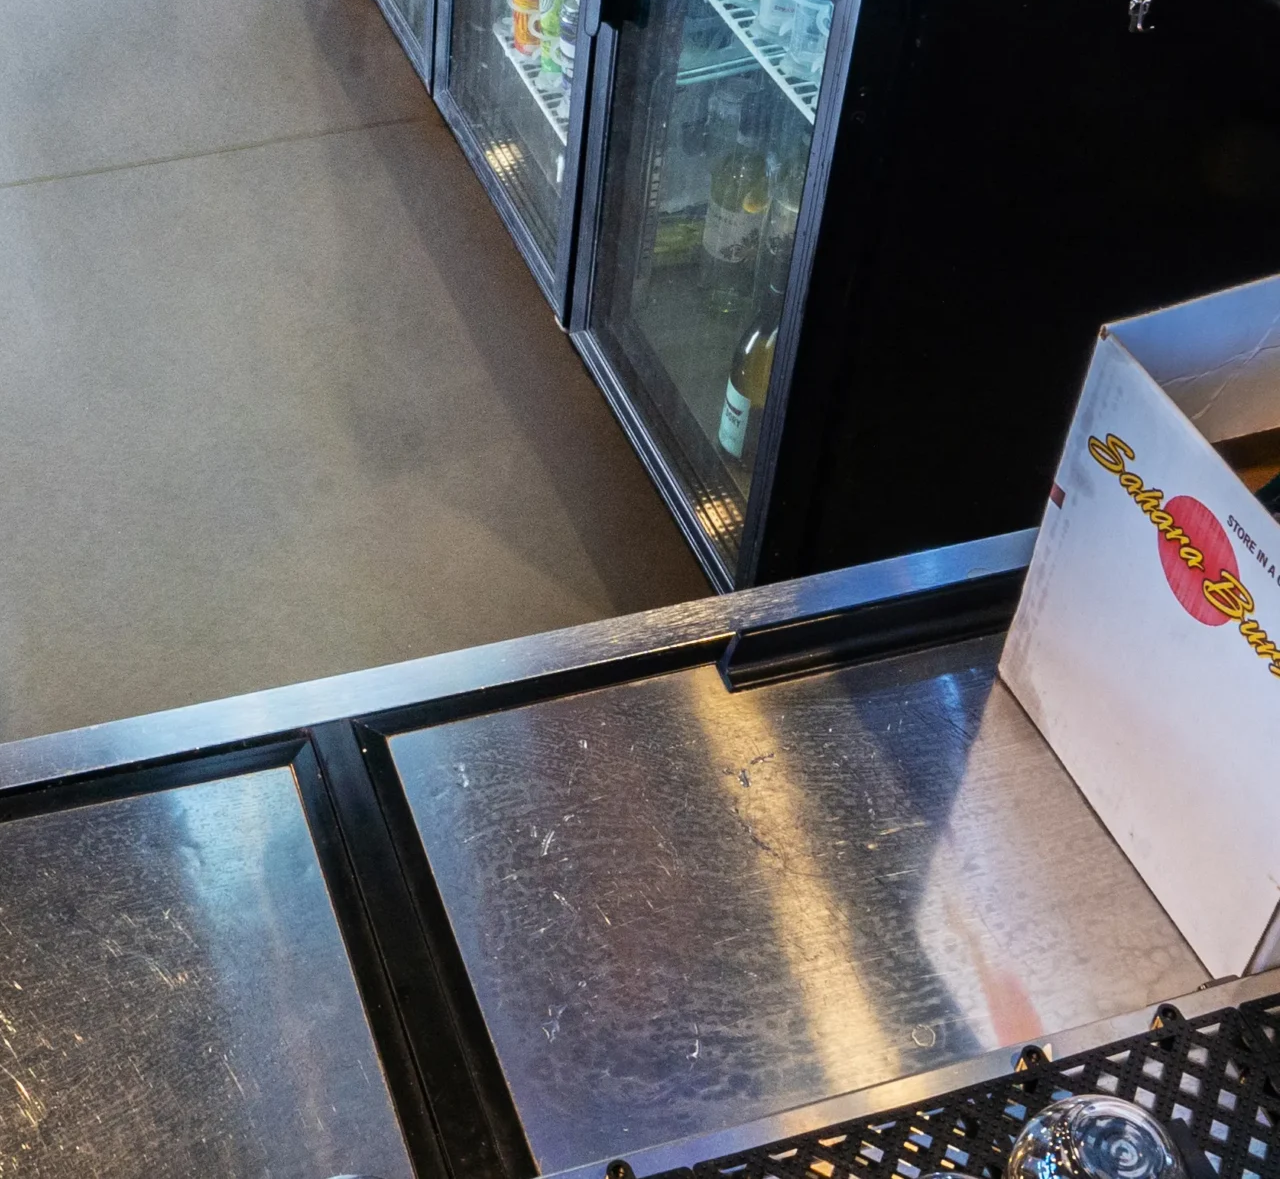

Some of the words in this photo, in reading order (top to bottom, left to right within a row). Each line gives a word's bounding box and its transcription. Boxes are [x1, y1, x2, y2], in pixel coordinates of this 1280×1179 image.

[1088, 432, 1207, 574] Sahara
[1226, 514, 1257, 555] STORE
[1256, 549, 1269, 569] IN
[1267, 564, 1276, 579] A
